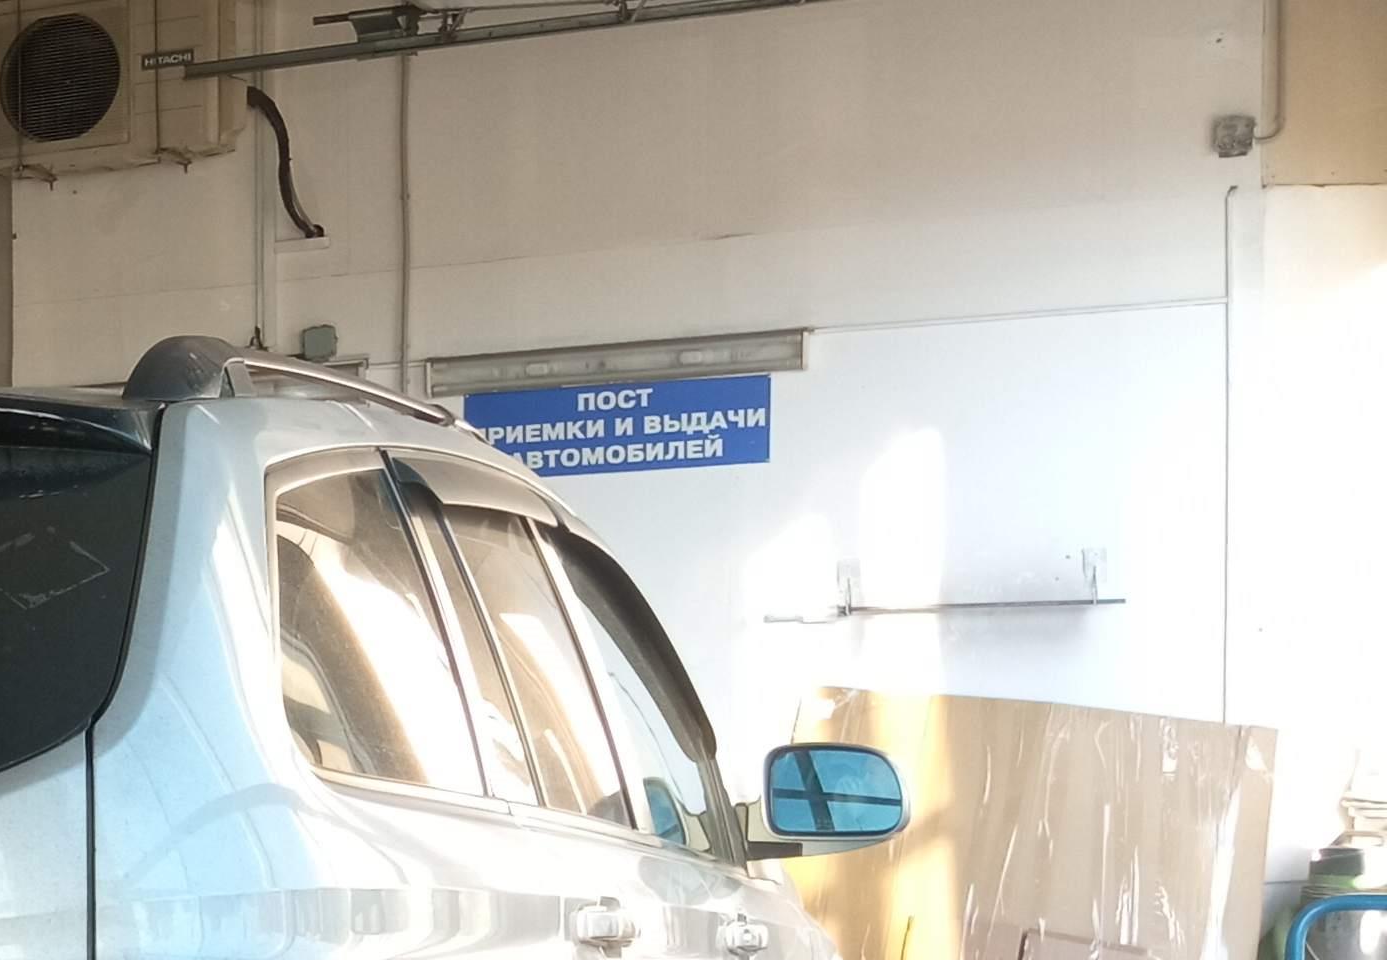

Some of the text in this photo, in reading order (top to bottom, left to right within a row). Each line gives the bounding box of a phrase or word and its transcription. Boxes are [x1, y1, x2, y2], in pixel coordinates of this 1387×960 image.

[144, 53, 192, 67] HITACHI
[577, 388, 653, 412] ПОСТ
[614, 419, 634, 437] И
[643, 407, 766, 436] ВЫДАЧИ
